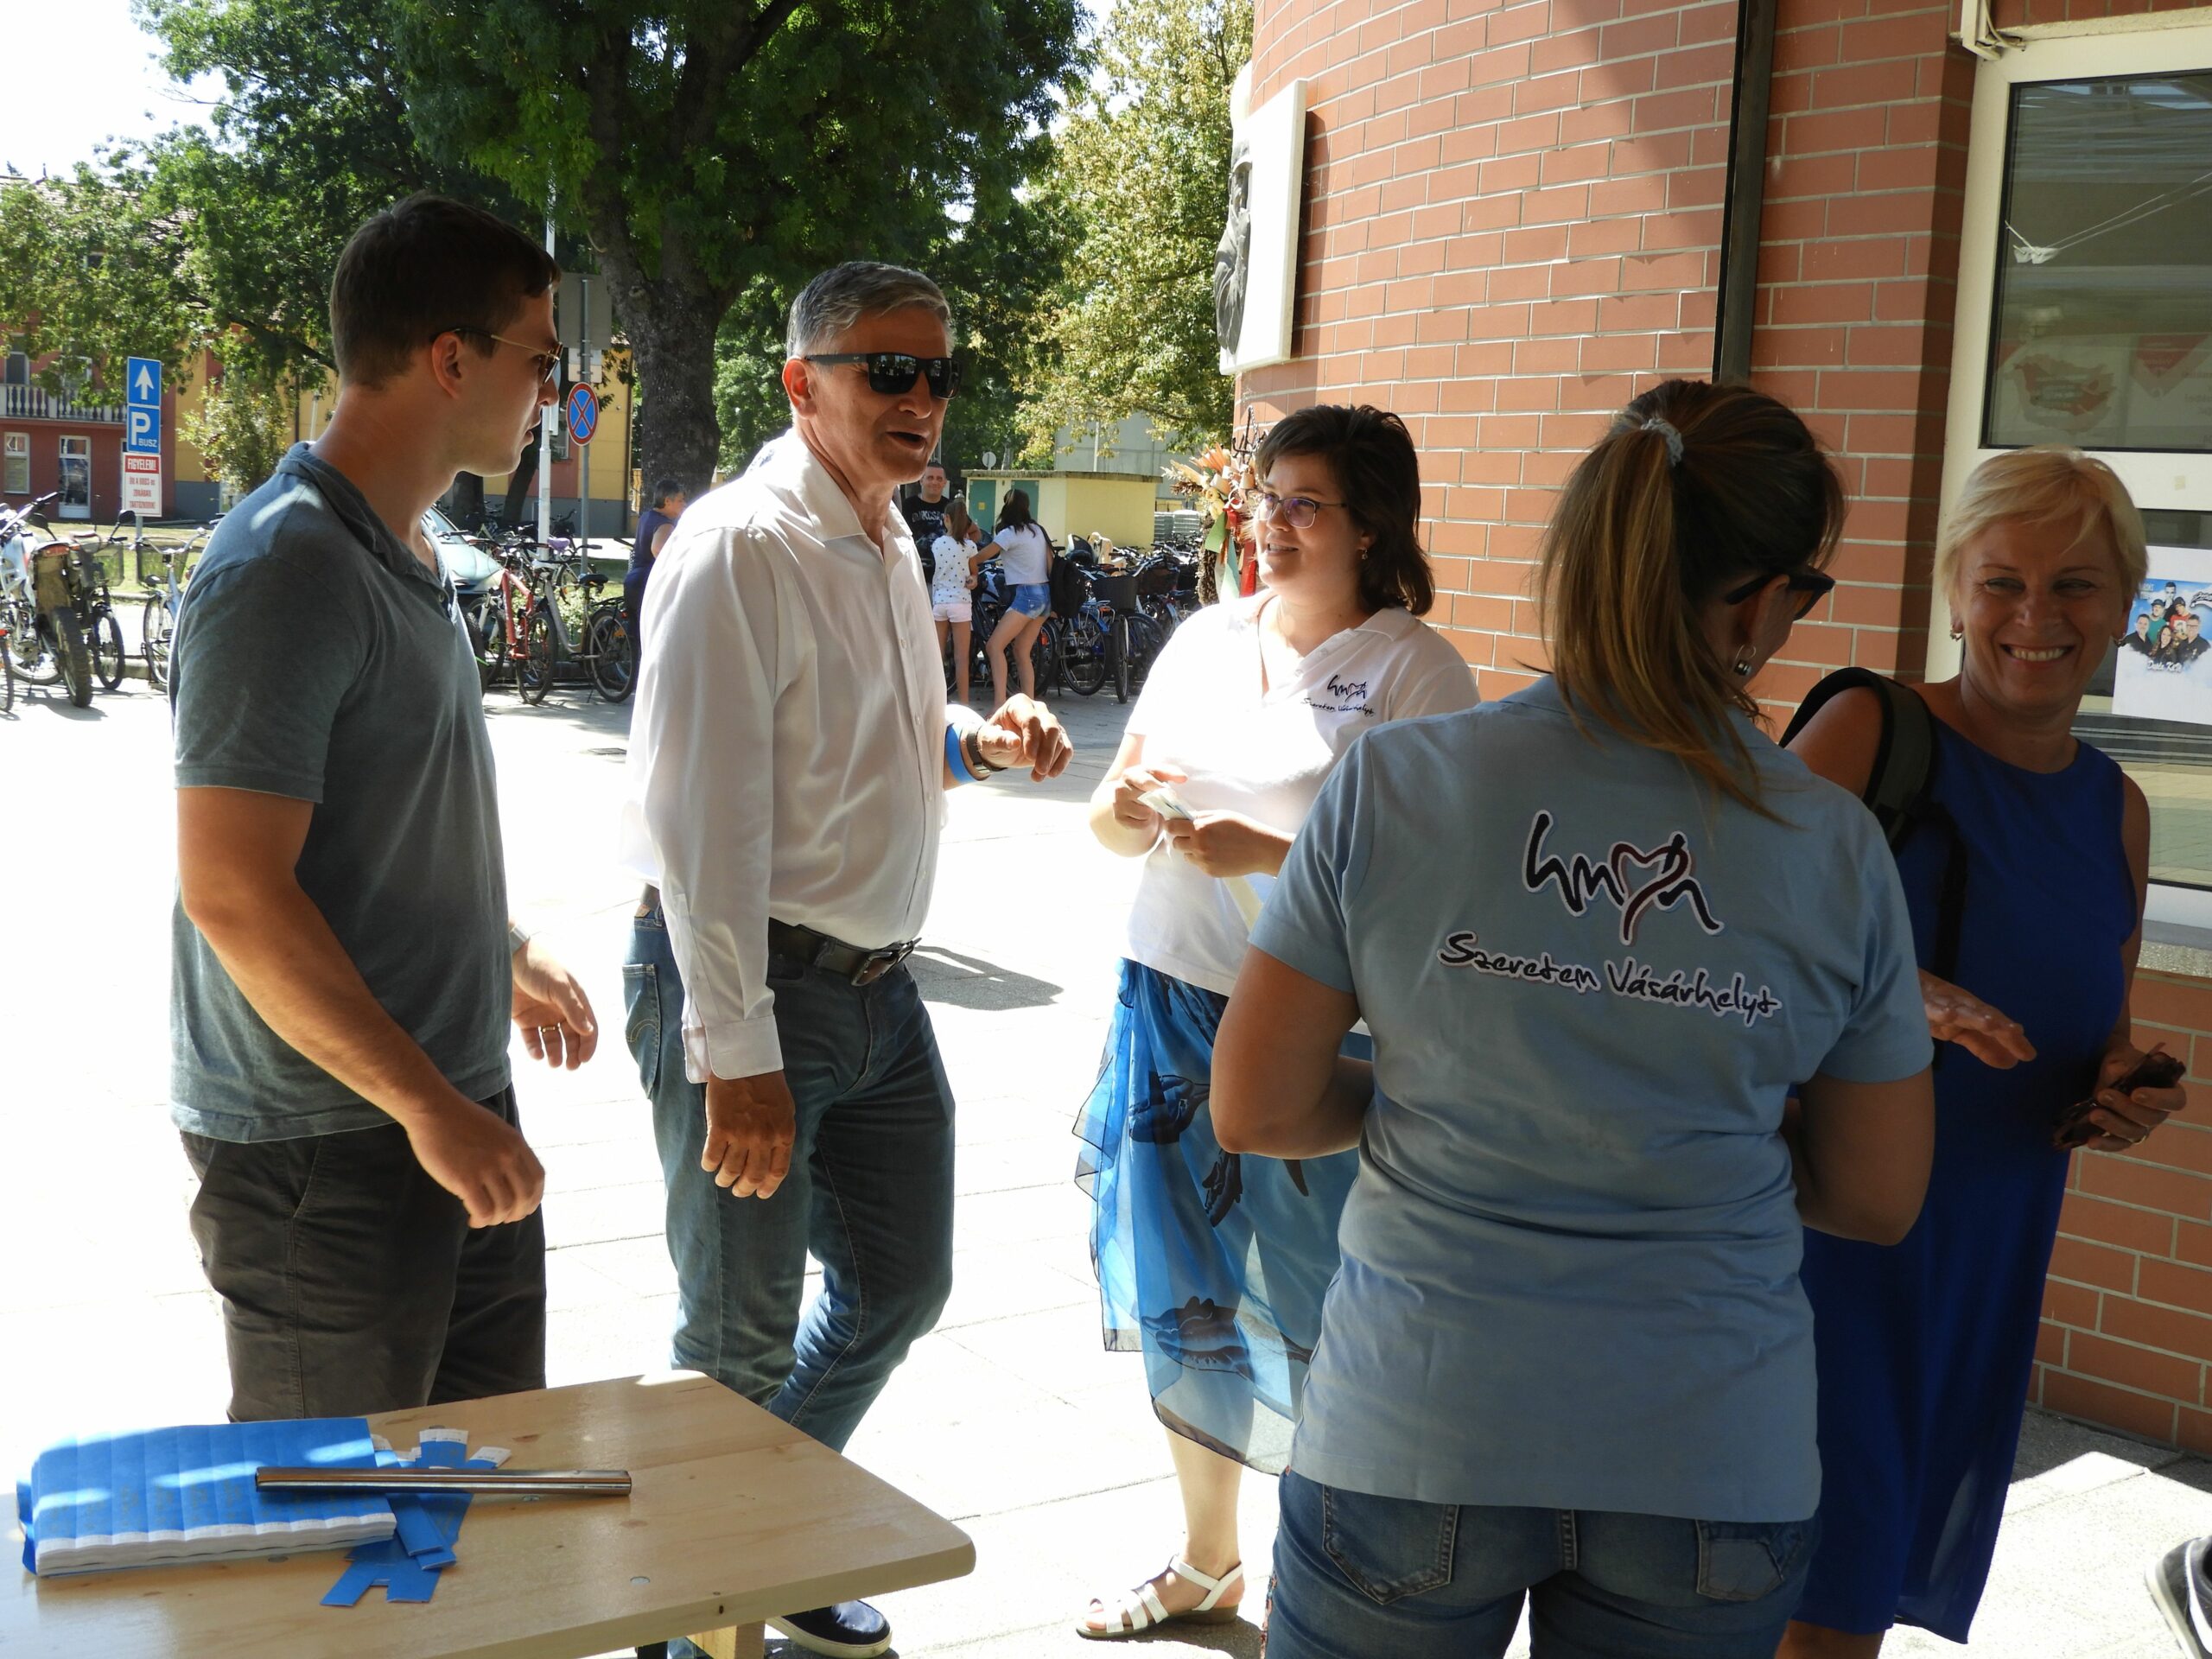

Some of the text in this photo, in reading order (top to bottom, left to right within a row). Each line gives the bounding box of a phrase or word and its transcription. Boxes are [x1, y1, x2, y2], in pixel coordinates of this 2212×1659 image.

[131, 411, 150, 446] P
[138, 438, 157, 448] BUSZ
[1439, 931, 1780, 1025] Szeretem Vásárhelyt
